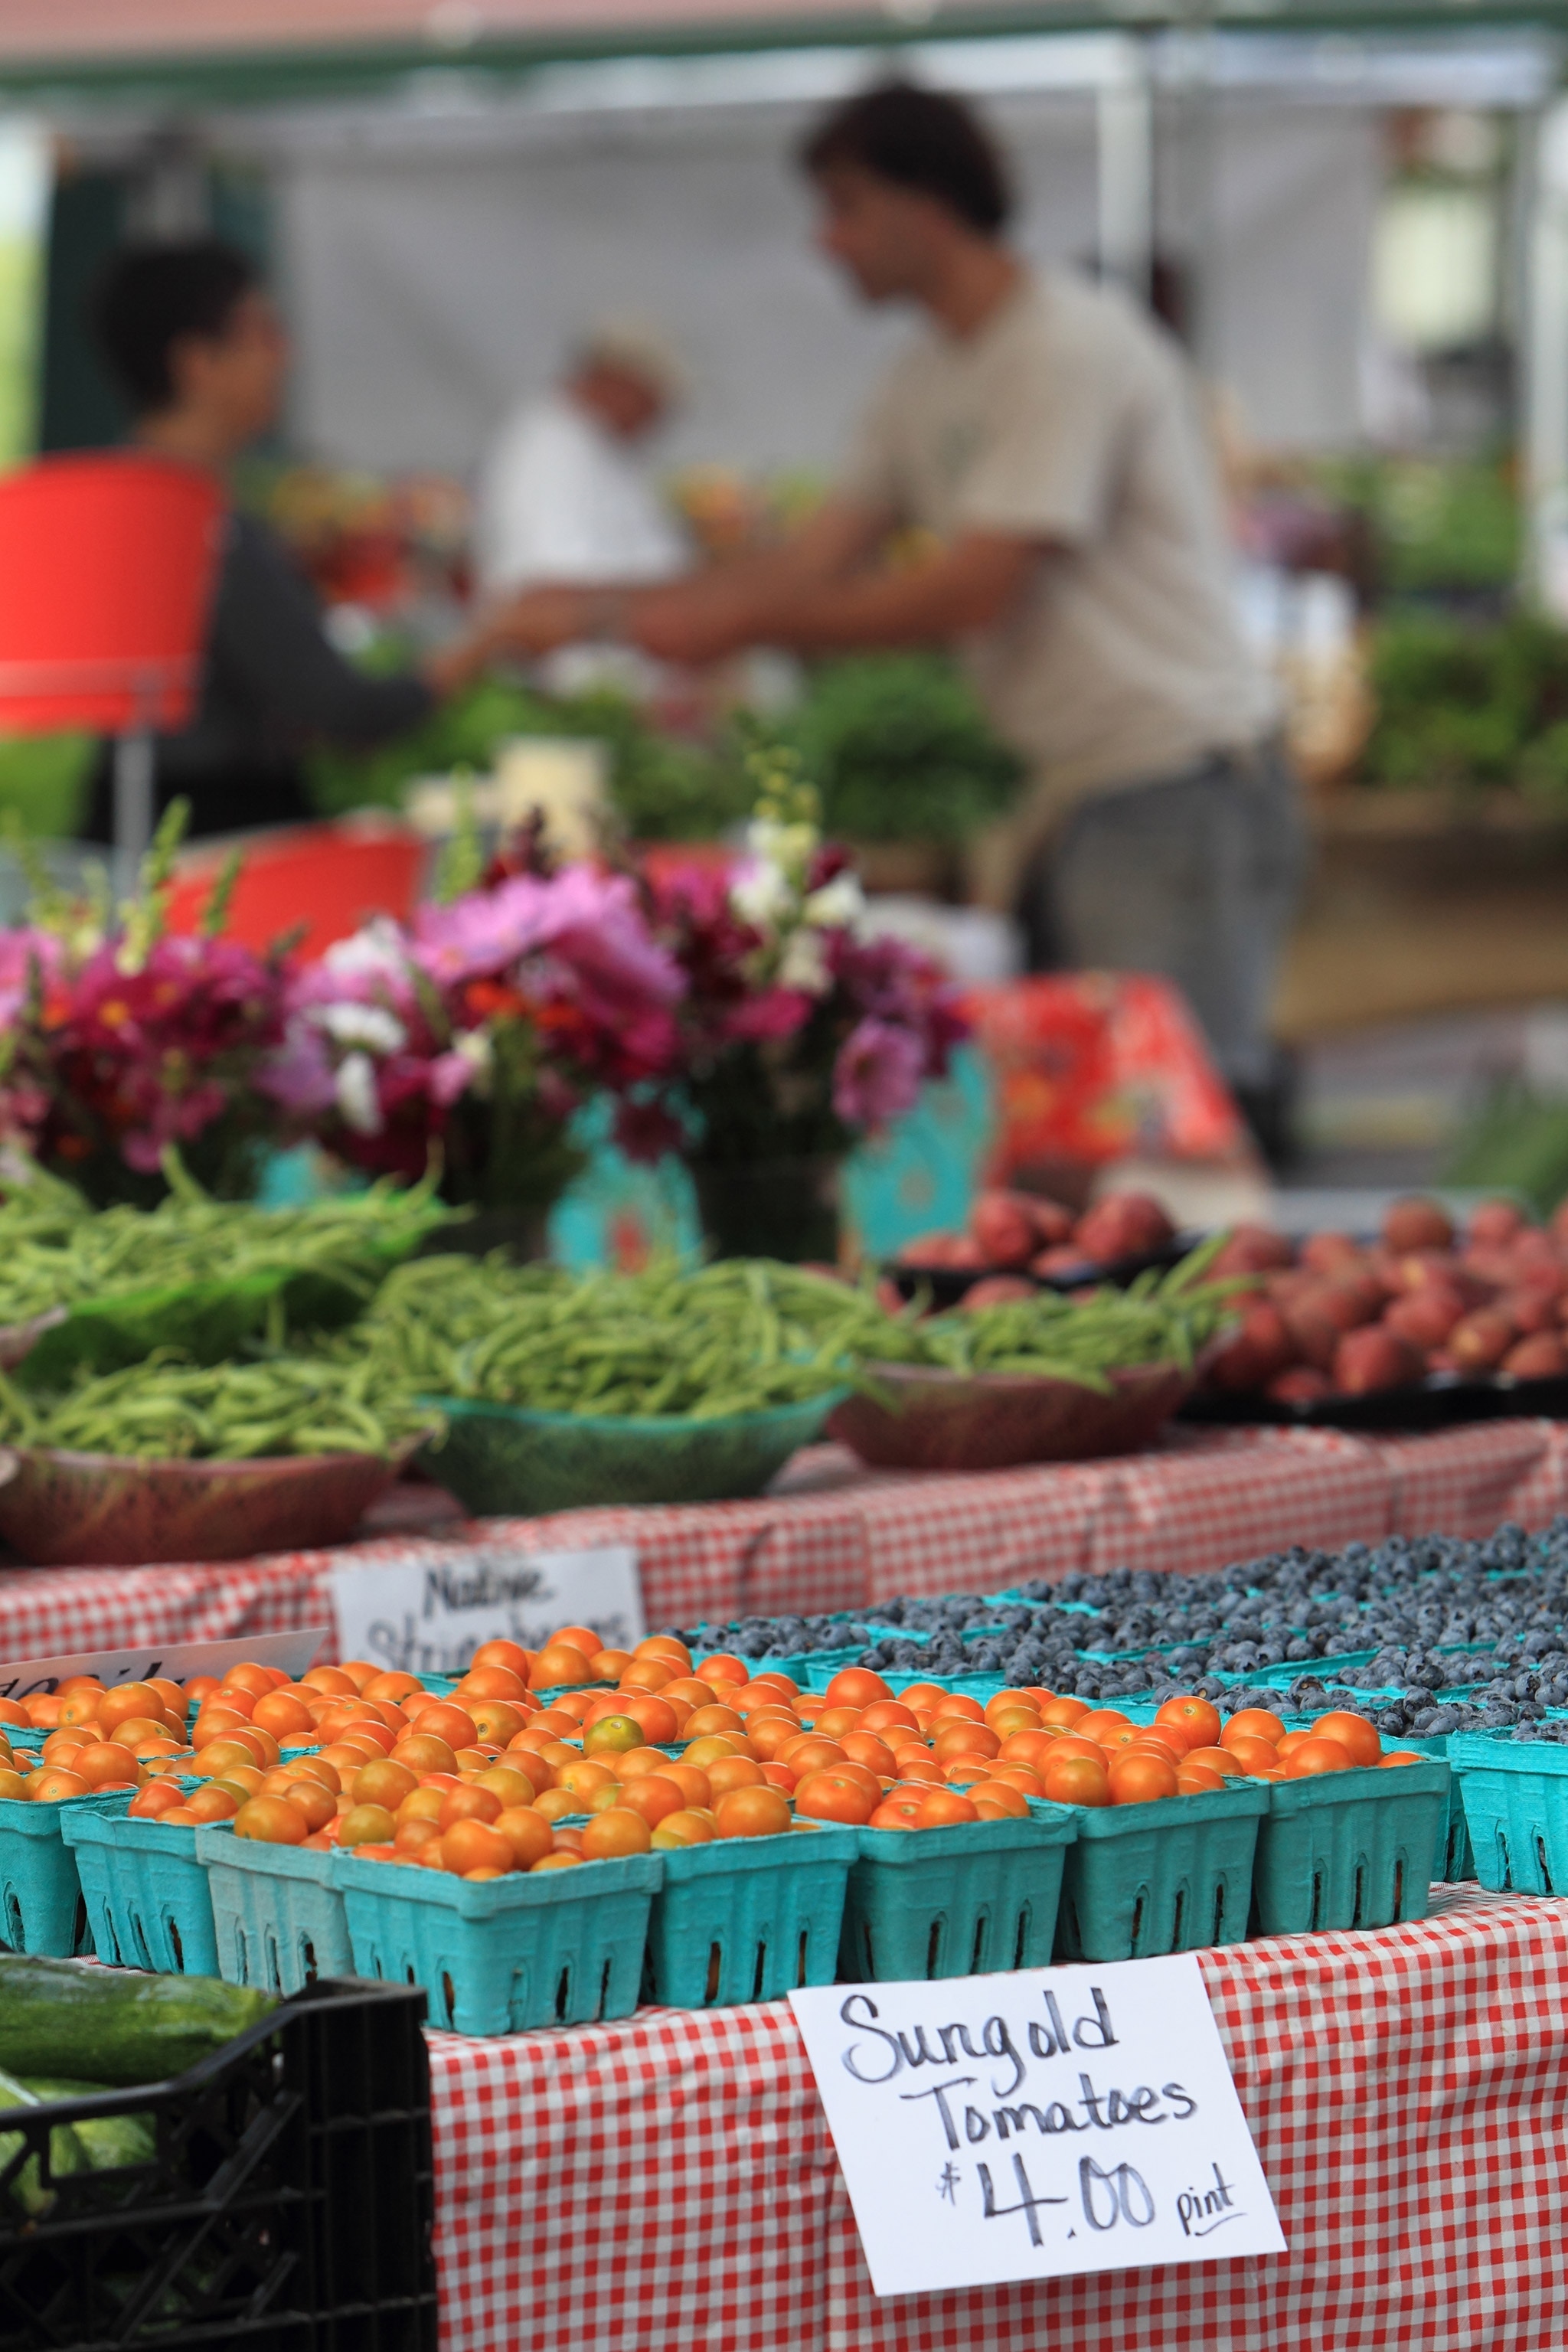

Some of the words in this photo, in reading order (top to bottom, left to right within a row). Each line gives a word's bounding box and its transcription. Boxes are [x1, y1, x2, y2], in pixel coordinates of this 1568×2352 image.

[841, 1988, 1119, 2096] Sungold
[900, 2073, 1197, 2150] Tomatoes
[936, 2153, 1156, 2248] $4.00
[1176, 2162, 1236, 2237] pint
